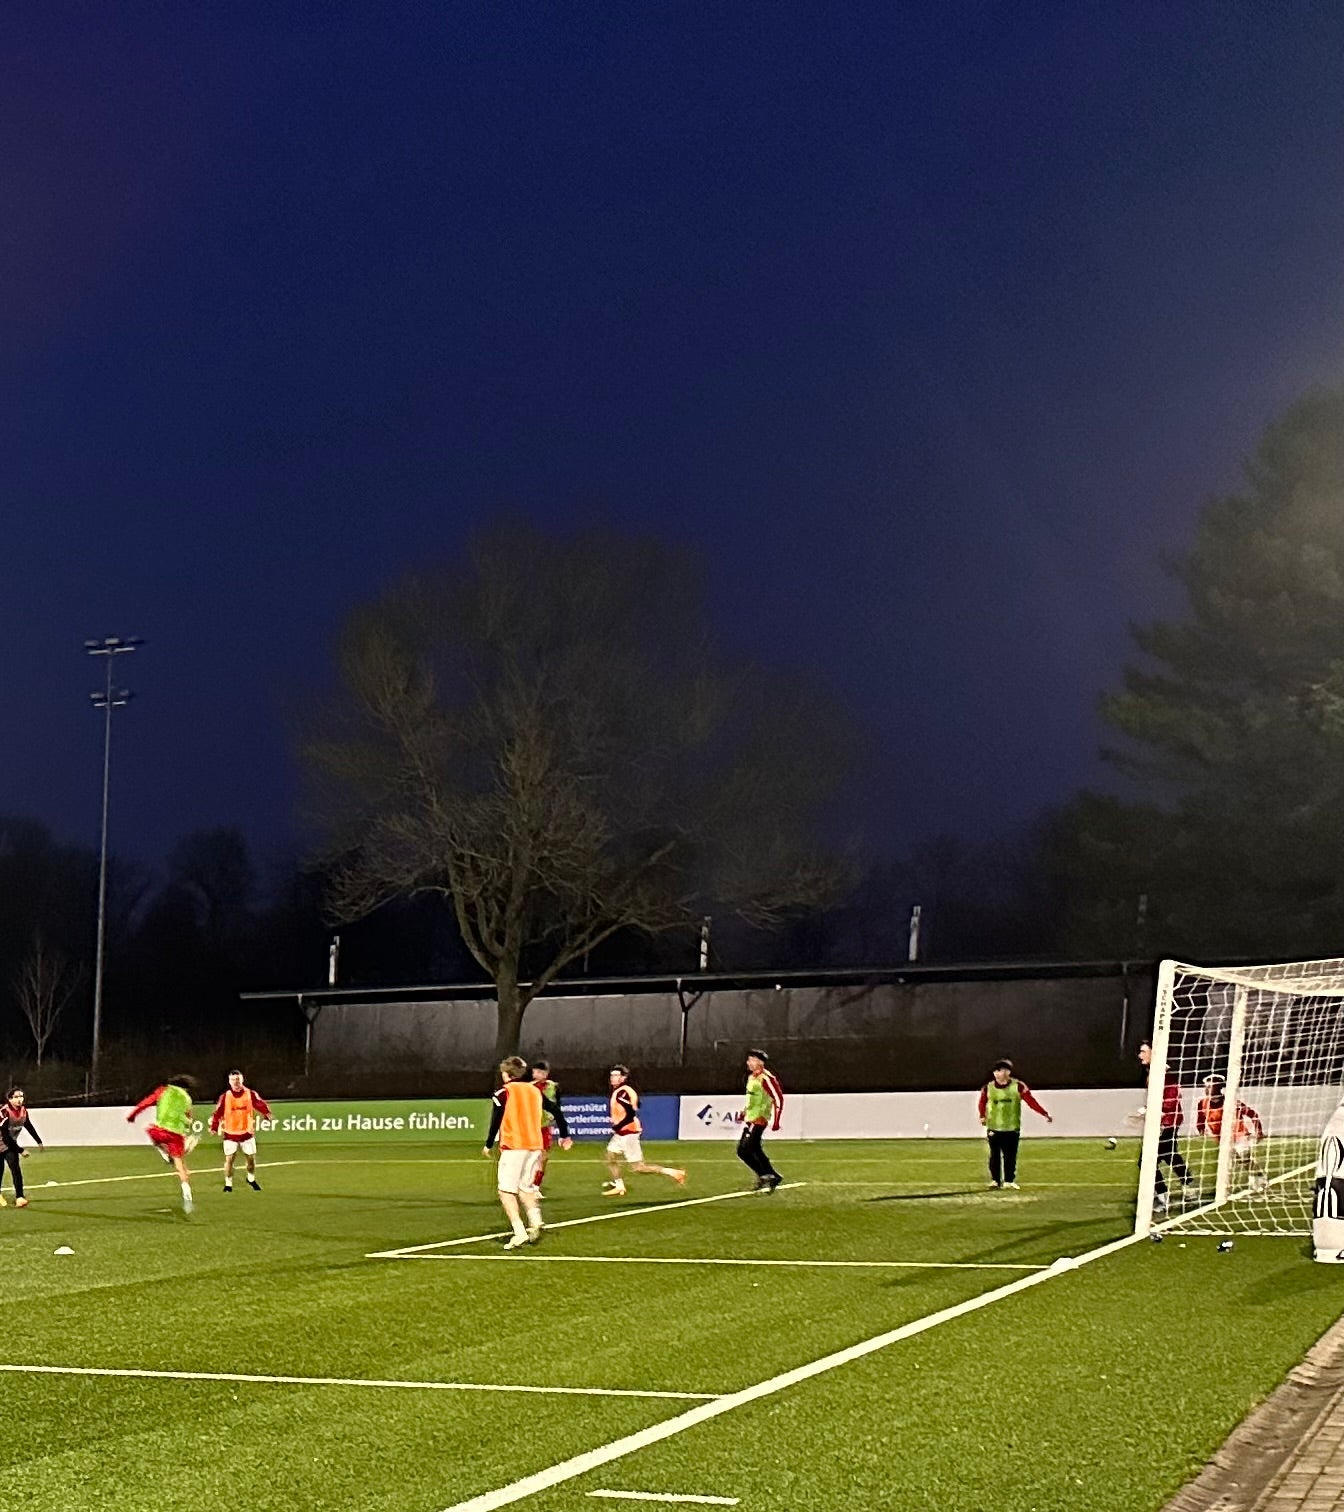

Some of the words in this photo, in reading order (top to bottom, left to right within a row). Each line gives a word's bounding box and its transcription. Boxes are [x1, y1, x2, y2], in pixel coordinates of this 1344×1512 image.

[282, 1115, 317, 1131] sich
[321, 1118, 342, 1131] zu
[347, 1114, 405, 1131] Hause
[408, 1112, 475, 1130] fühlen.
